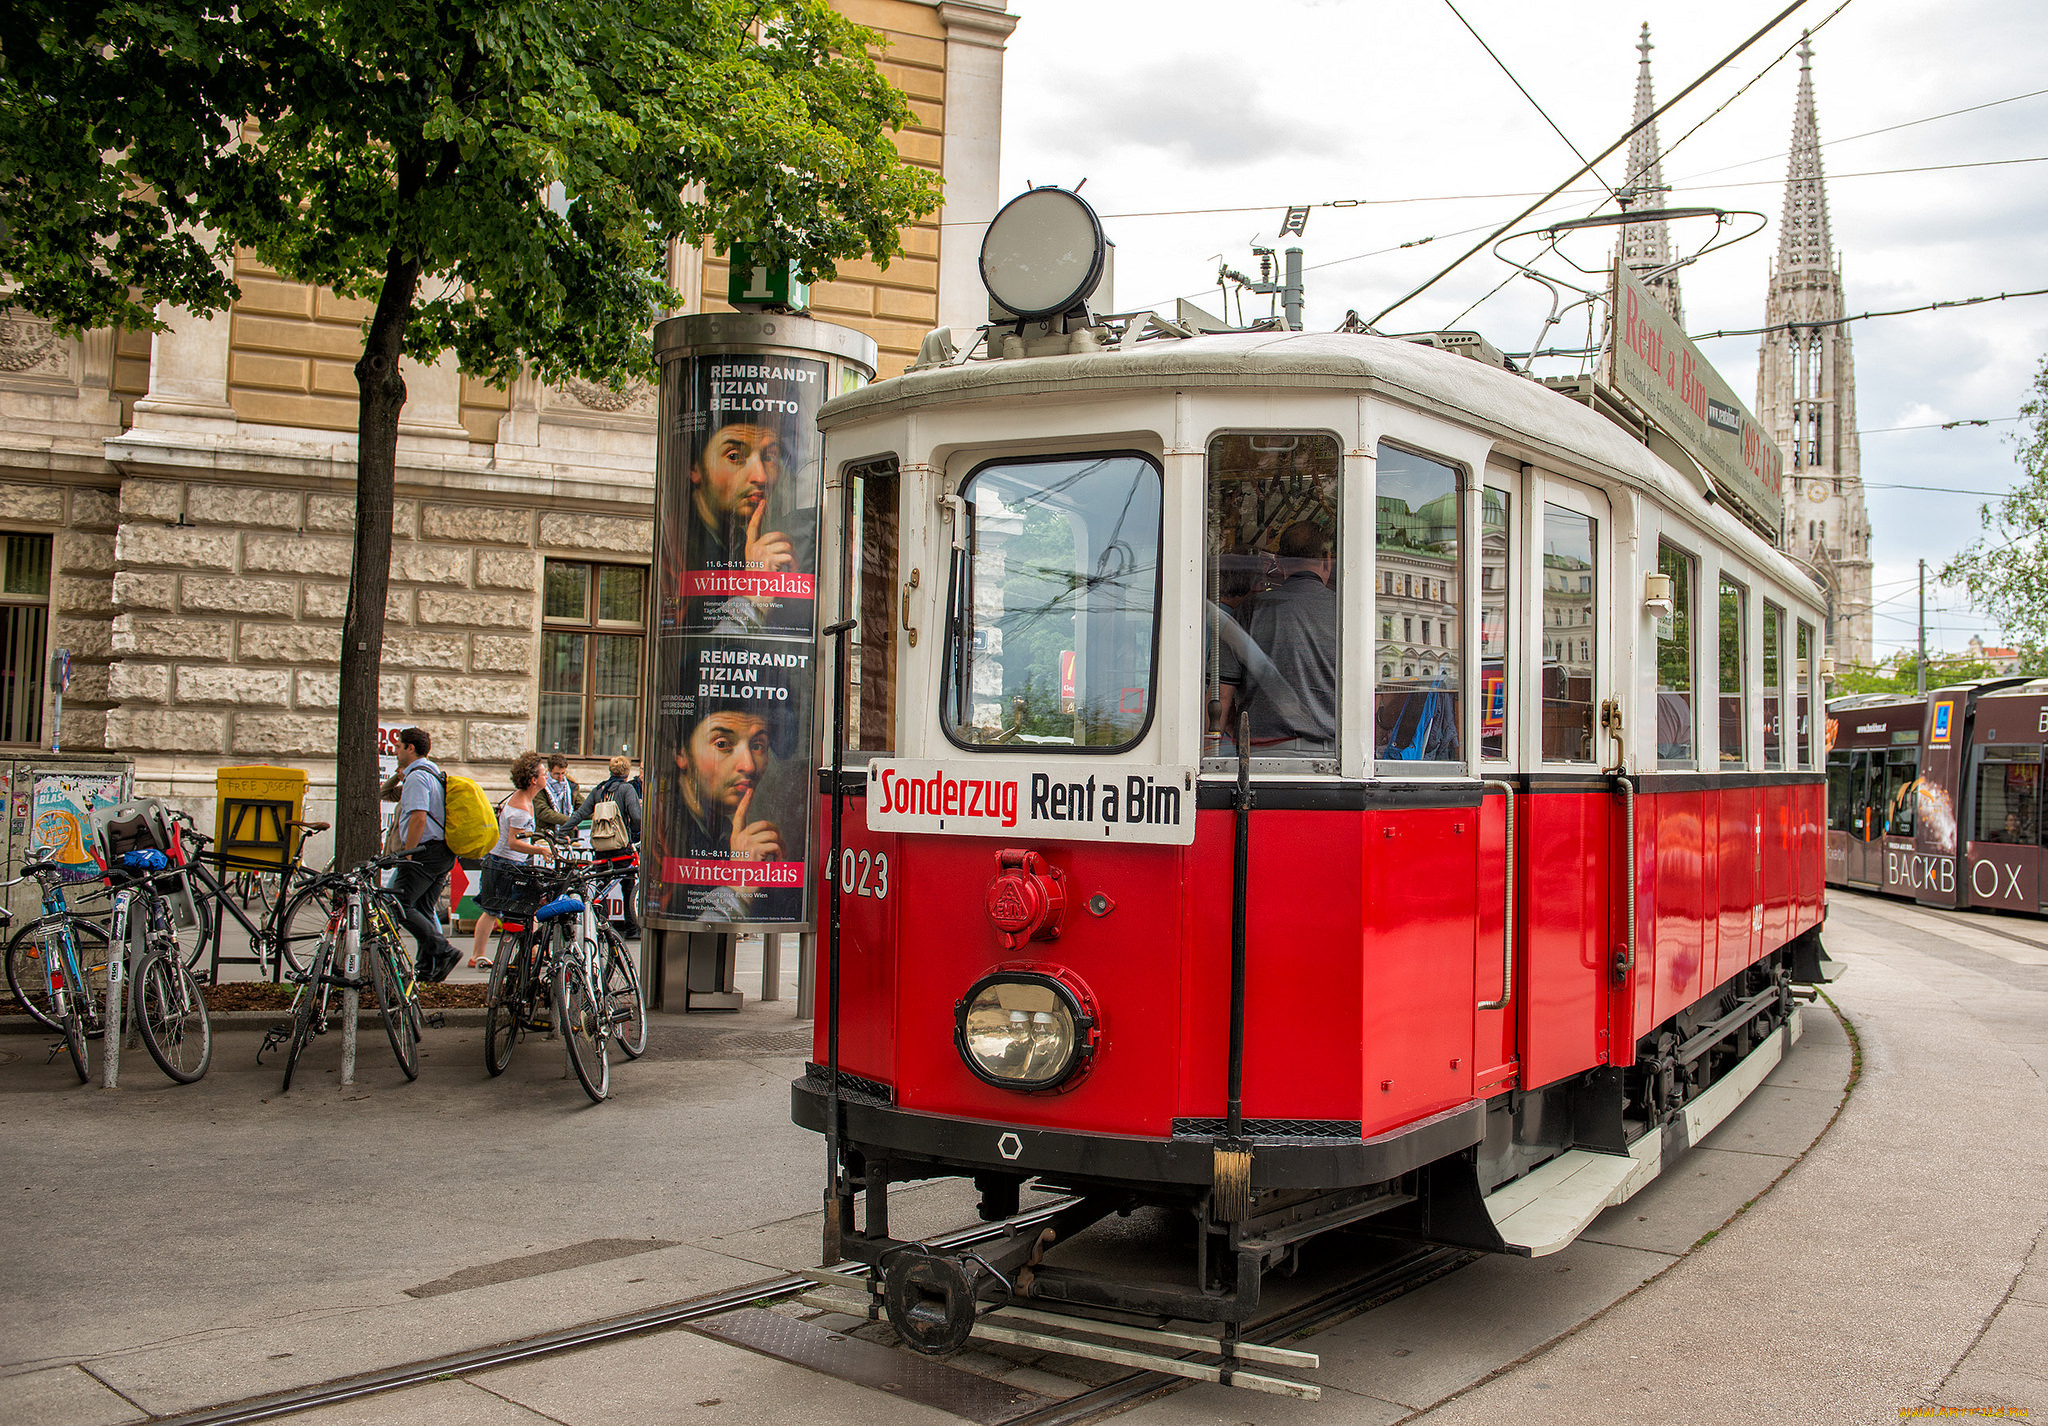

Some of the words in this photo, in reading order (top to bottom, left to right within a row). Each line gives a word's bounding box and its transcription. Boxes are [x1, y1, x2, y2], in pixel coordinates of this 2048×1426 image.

[1624, 284, 1663, 377] Rent
[1668, 350, 1676, 391] a
[1681, 346, 1707, 422] Bim
[710, 364, 817, 384] REMBRANDT
[709, 381, 768, 395] TIZIAN
[709, 397, 799, 415] BELLOTTO
[1744, 422, 1761, 477] 892
[1762, 443, 1771, 487] 13
[1771, 455, 1781, 499] 34
[694, 572, 811, 597] winterpalais
[700, 650, 809, 669] REMBRANDT
[699, 667, 758, 682] TIZIAN
[698, 683, 788, 701] BELLOTTO
[228, 780, 257, 793] FREE
[880, 768, 1018, 828] Sonderzug
[1031, 772, 1096, 822] Rent
[1102, 784, 1119, 823] a
[1127, 775, 1180, 825] Bim
[678, 861, 798, 887] winterpalais
